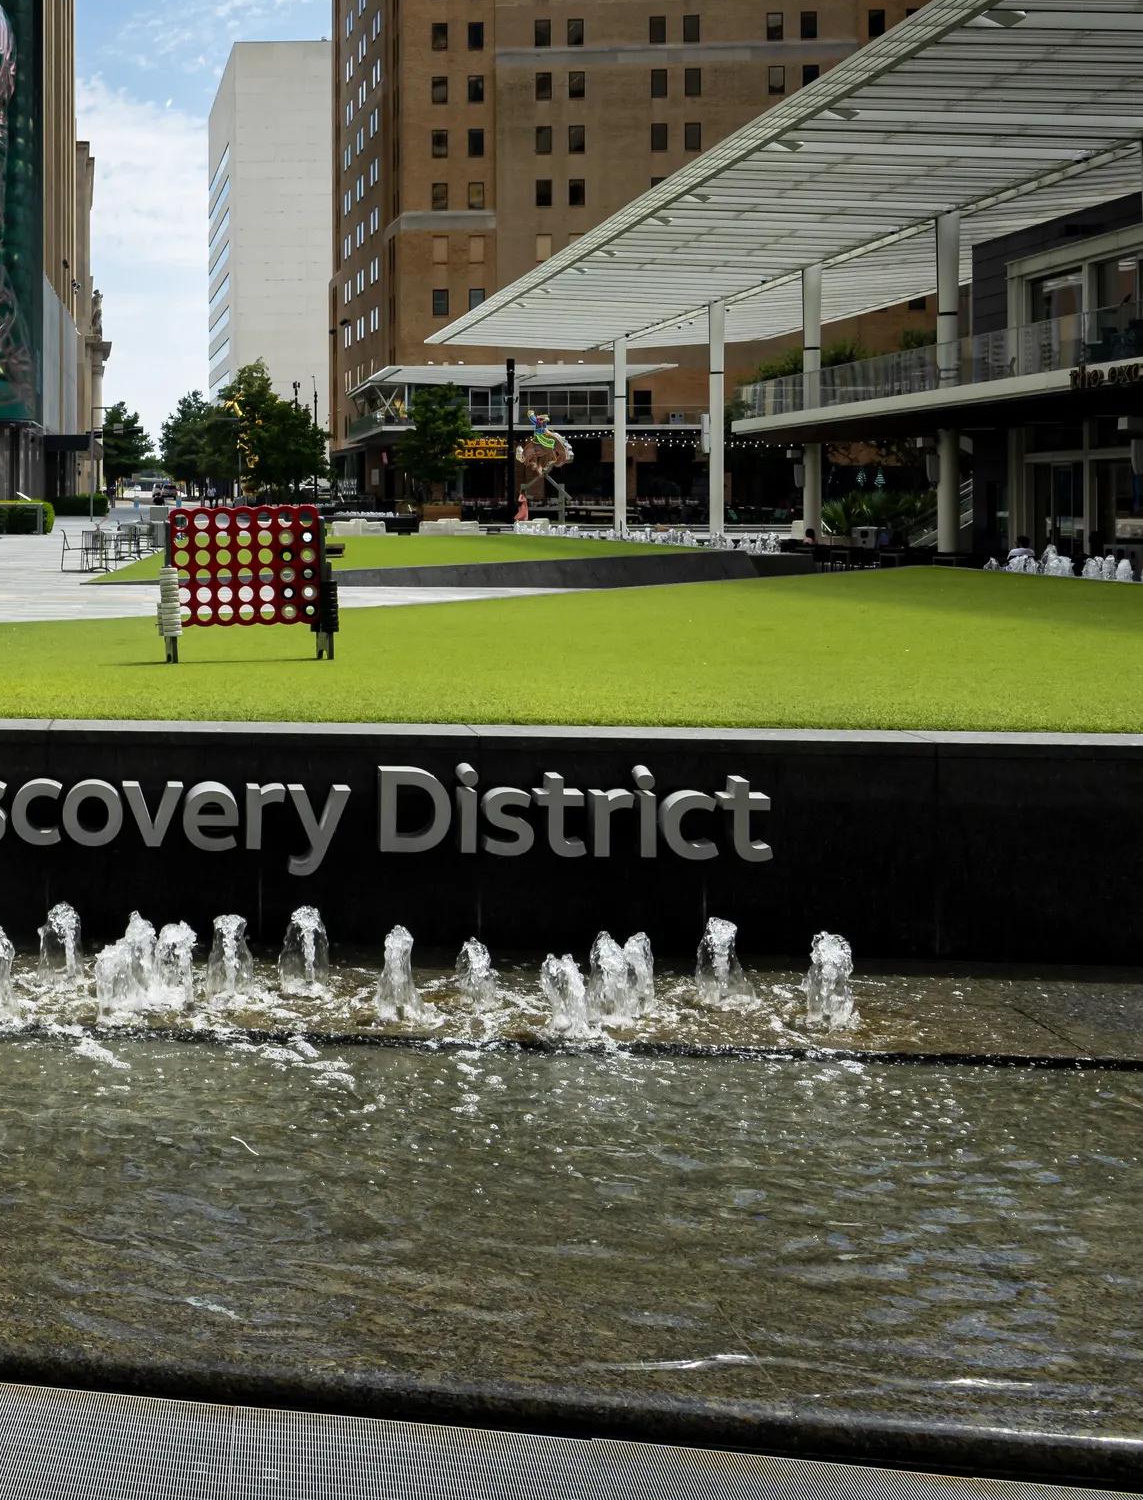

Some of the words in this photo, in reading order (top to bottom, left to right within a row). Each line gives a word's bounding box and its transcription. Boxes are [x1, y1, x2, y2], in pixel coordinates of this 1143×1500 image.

[456, 438, 507, 447] OWBOY
[455, 449, 497, 458] CHOW
[377, 762, 774, 863] District
